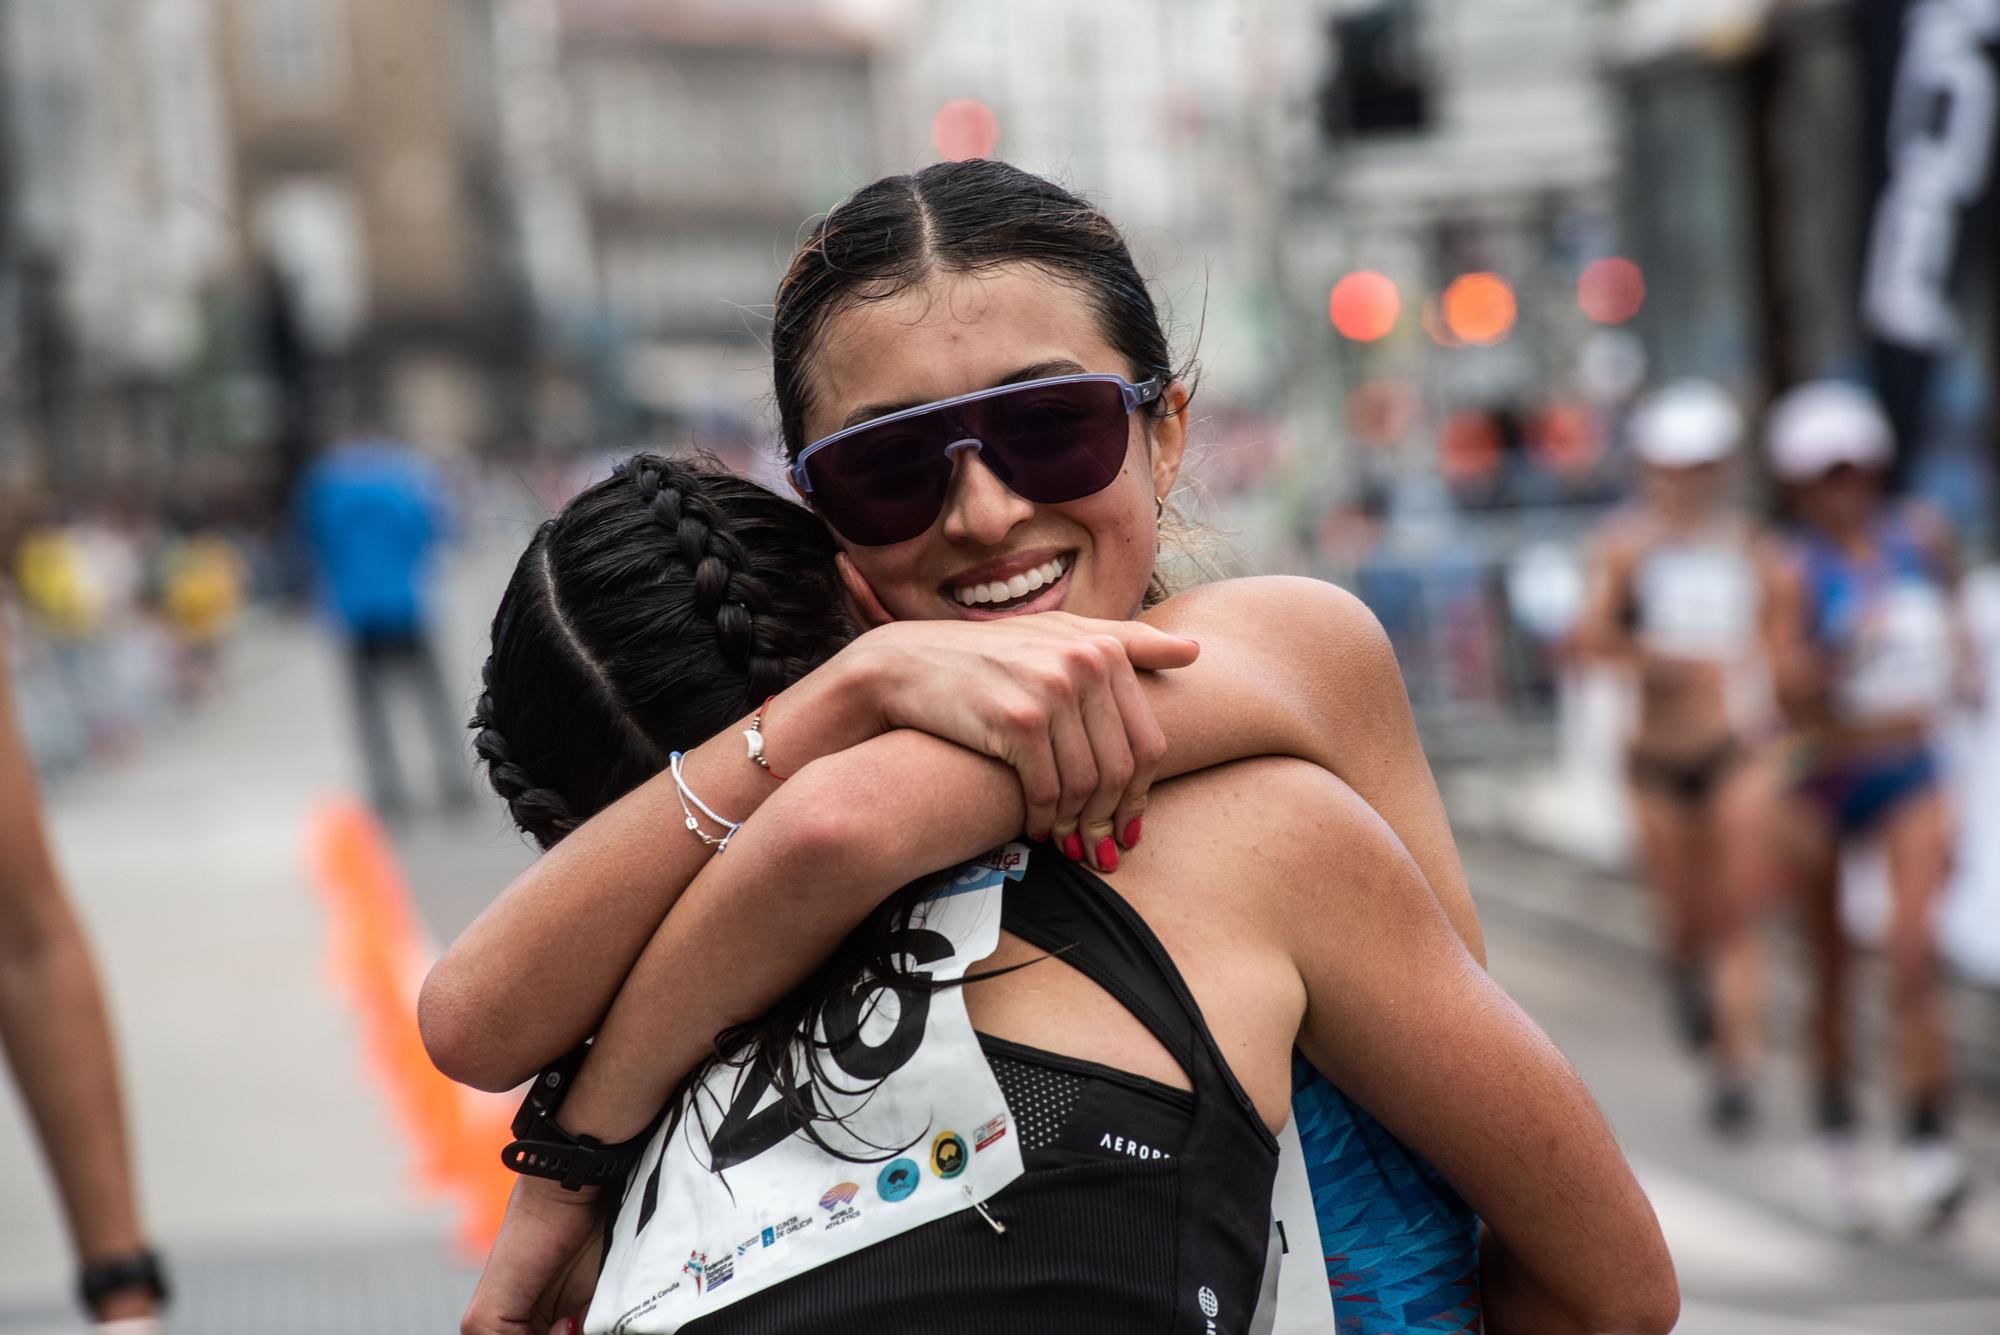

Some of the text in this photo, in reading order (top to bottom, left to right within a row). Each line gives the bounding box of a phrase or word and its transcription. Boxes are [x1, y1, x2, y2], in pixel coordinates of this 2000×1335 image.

[825, 1210, 861, 1231] ATHLETICS
[830, 1206, 854, 1221] WORLD
[776, 1216, 798, 1231] XUNTA
[776, 1217, 813, 1239] DE GALICIA
[658, 1282, 680, 1298] Coruña
